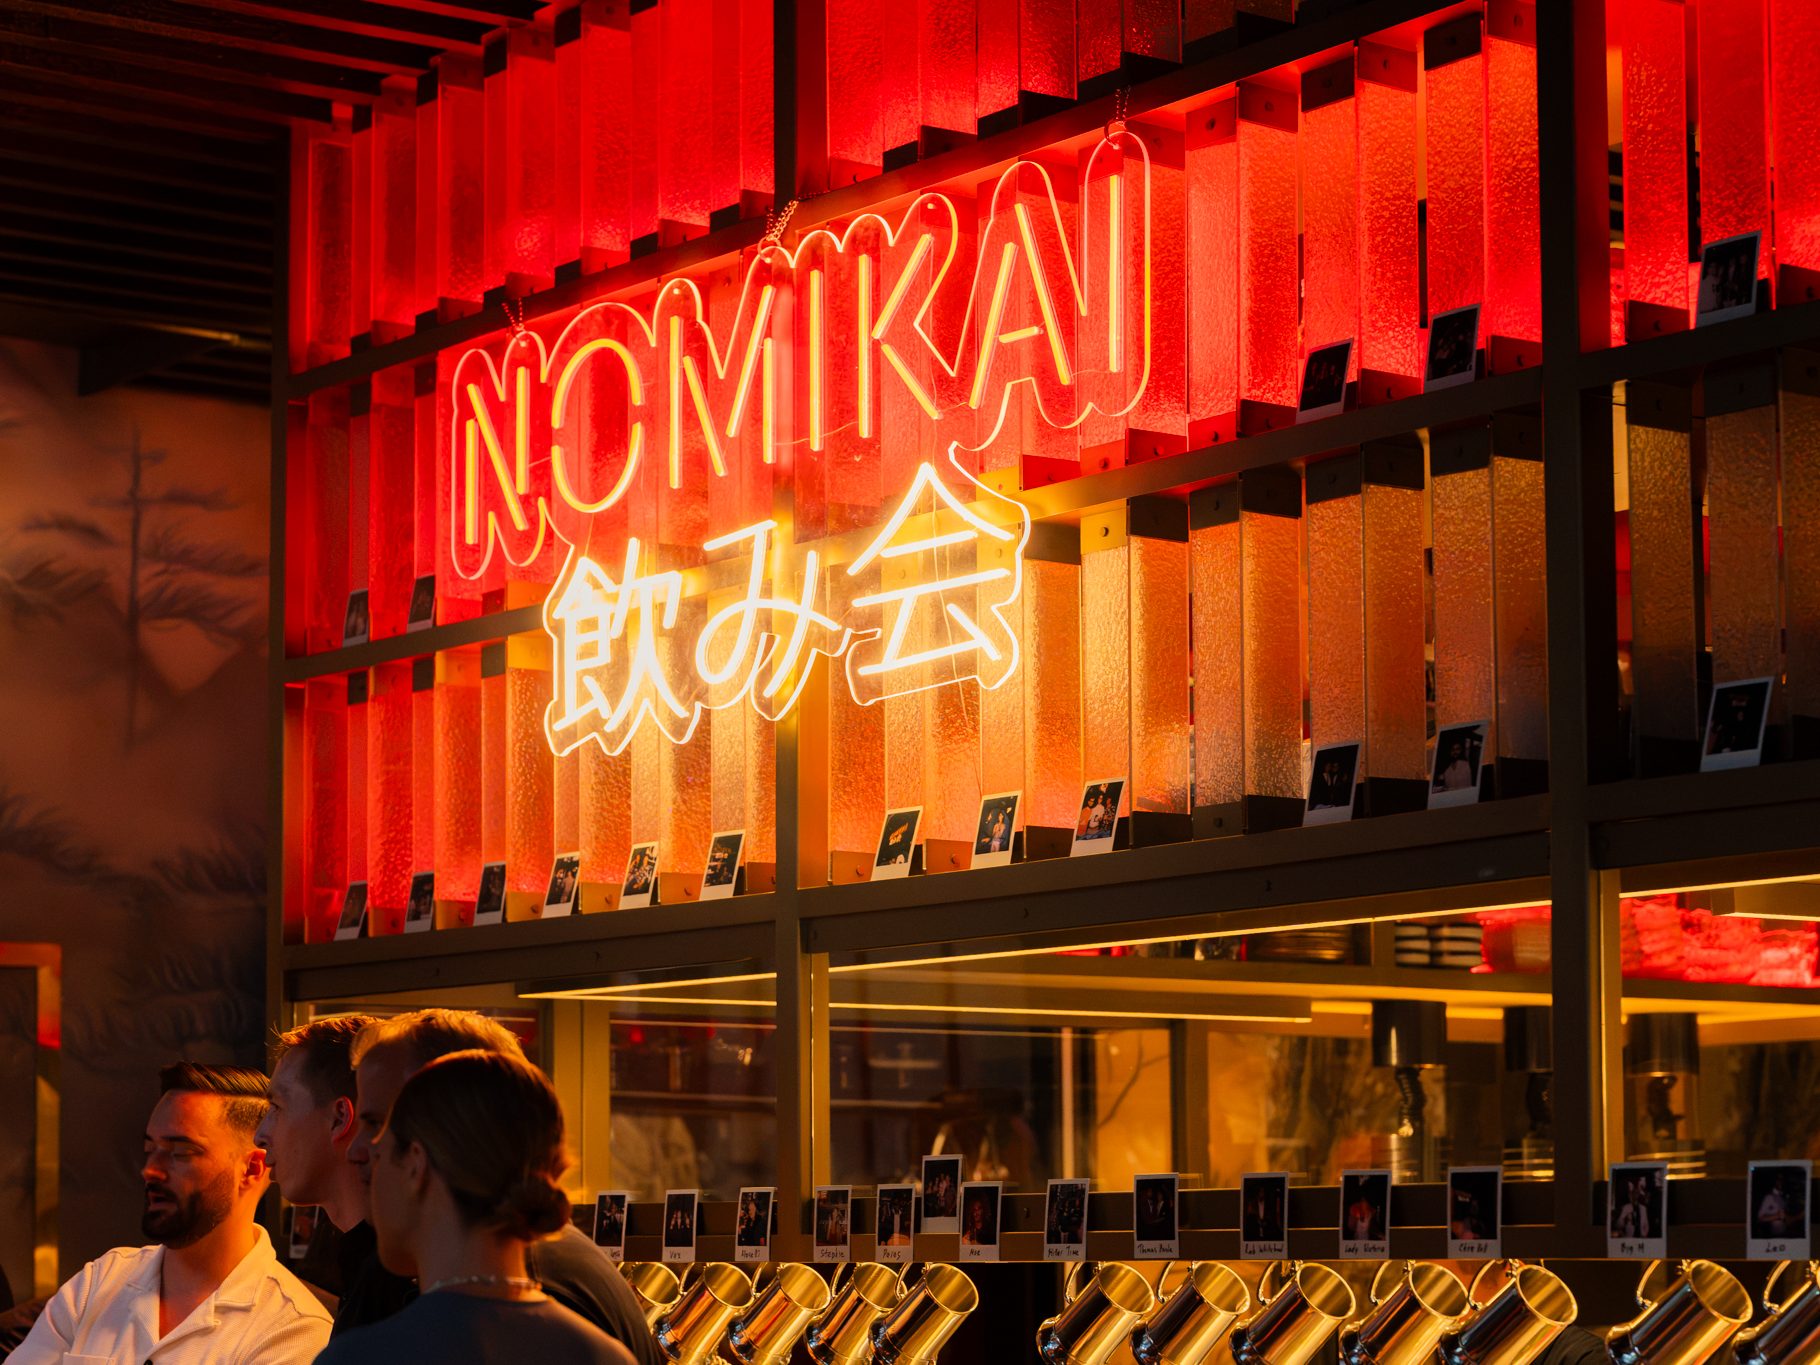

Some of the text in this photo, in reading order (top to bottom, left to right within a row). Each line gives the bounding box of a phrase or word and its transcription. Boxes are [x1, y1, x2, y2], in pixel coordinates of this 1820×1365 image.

[465, 174, 1121, 545] NOMIKAI
[552, 462, 1014, 732] 飲み会
